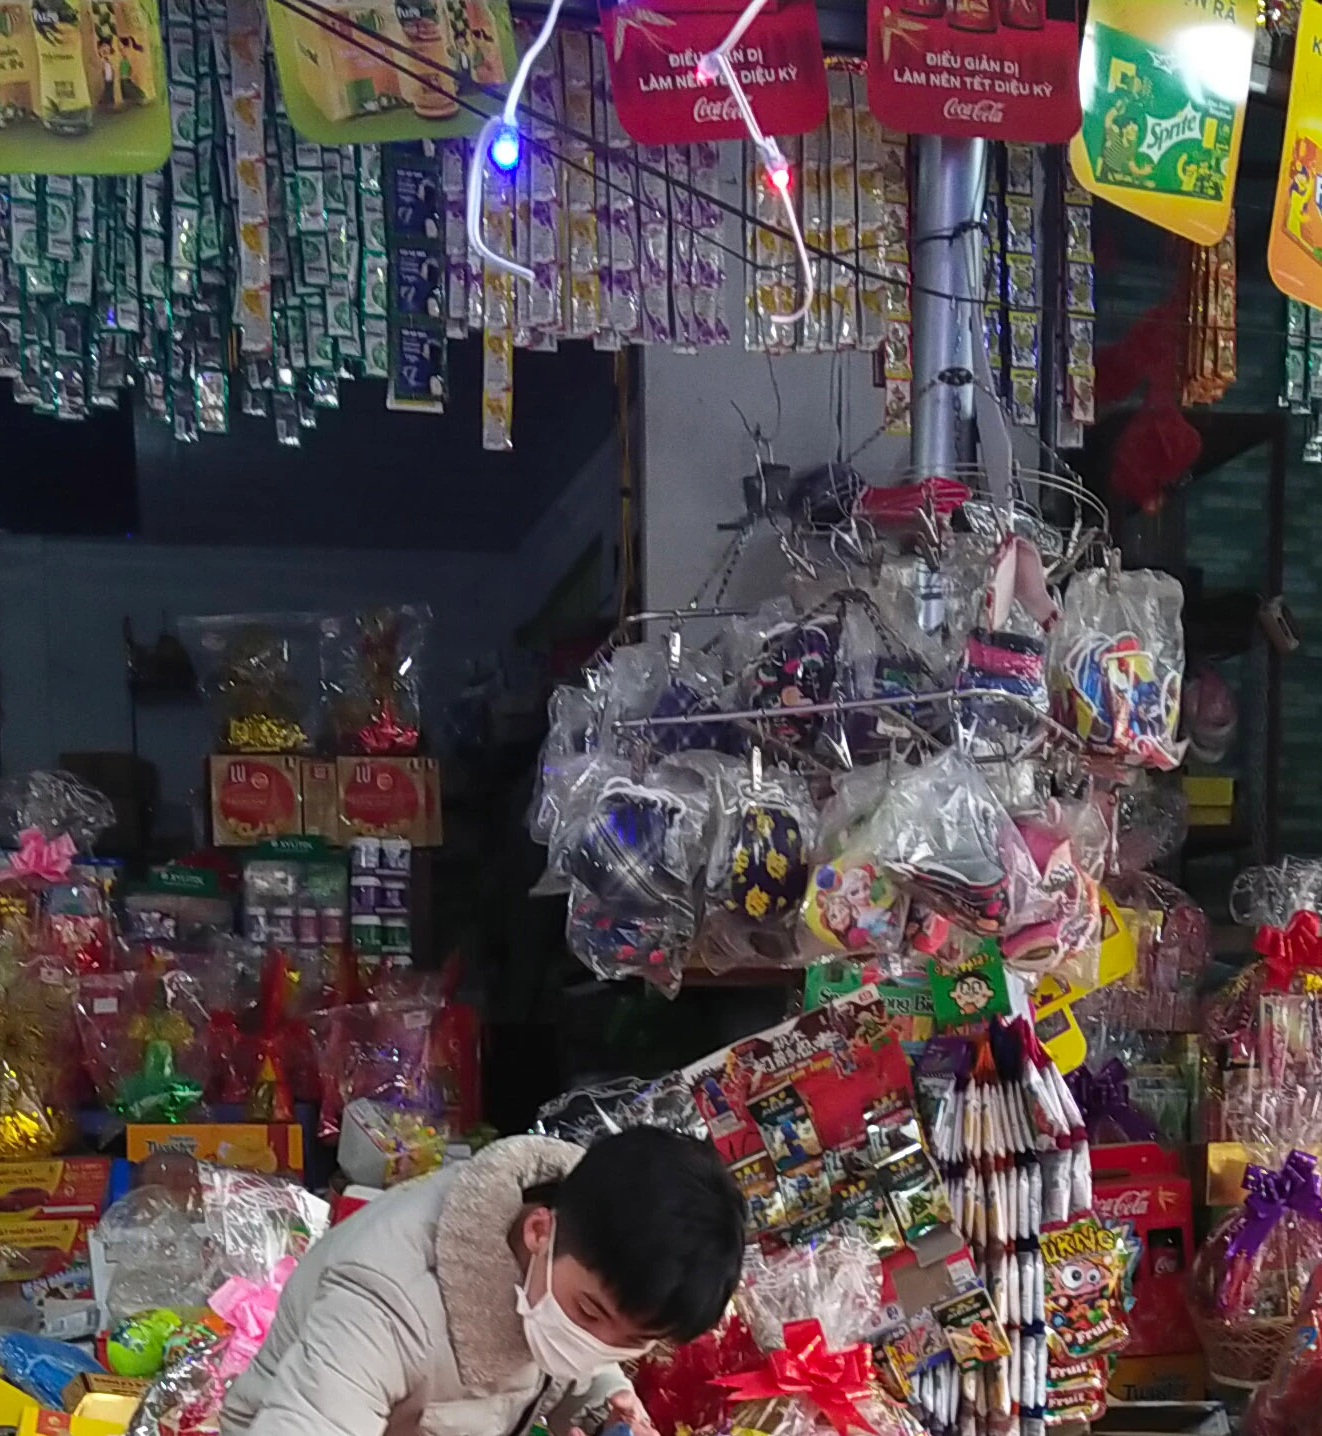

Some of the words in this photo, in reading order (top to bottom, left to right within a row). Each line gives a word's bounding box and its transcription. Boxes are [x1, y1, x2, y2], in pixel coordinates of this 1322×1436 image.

[894, 66, 926, 86] LÀM
[929, 71, 961, 90] NÊN
[964, 74, 992, 92] TẾT
[1147, 113, 1196, 150] Sprite
[1076, 1319, 1115, 1346] Fruit
[1050, 1360, 1090, 1380] Fruit
[1048, 1392, 1087, 1409] Fruit
